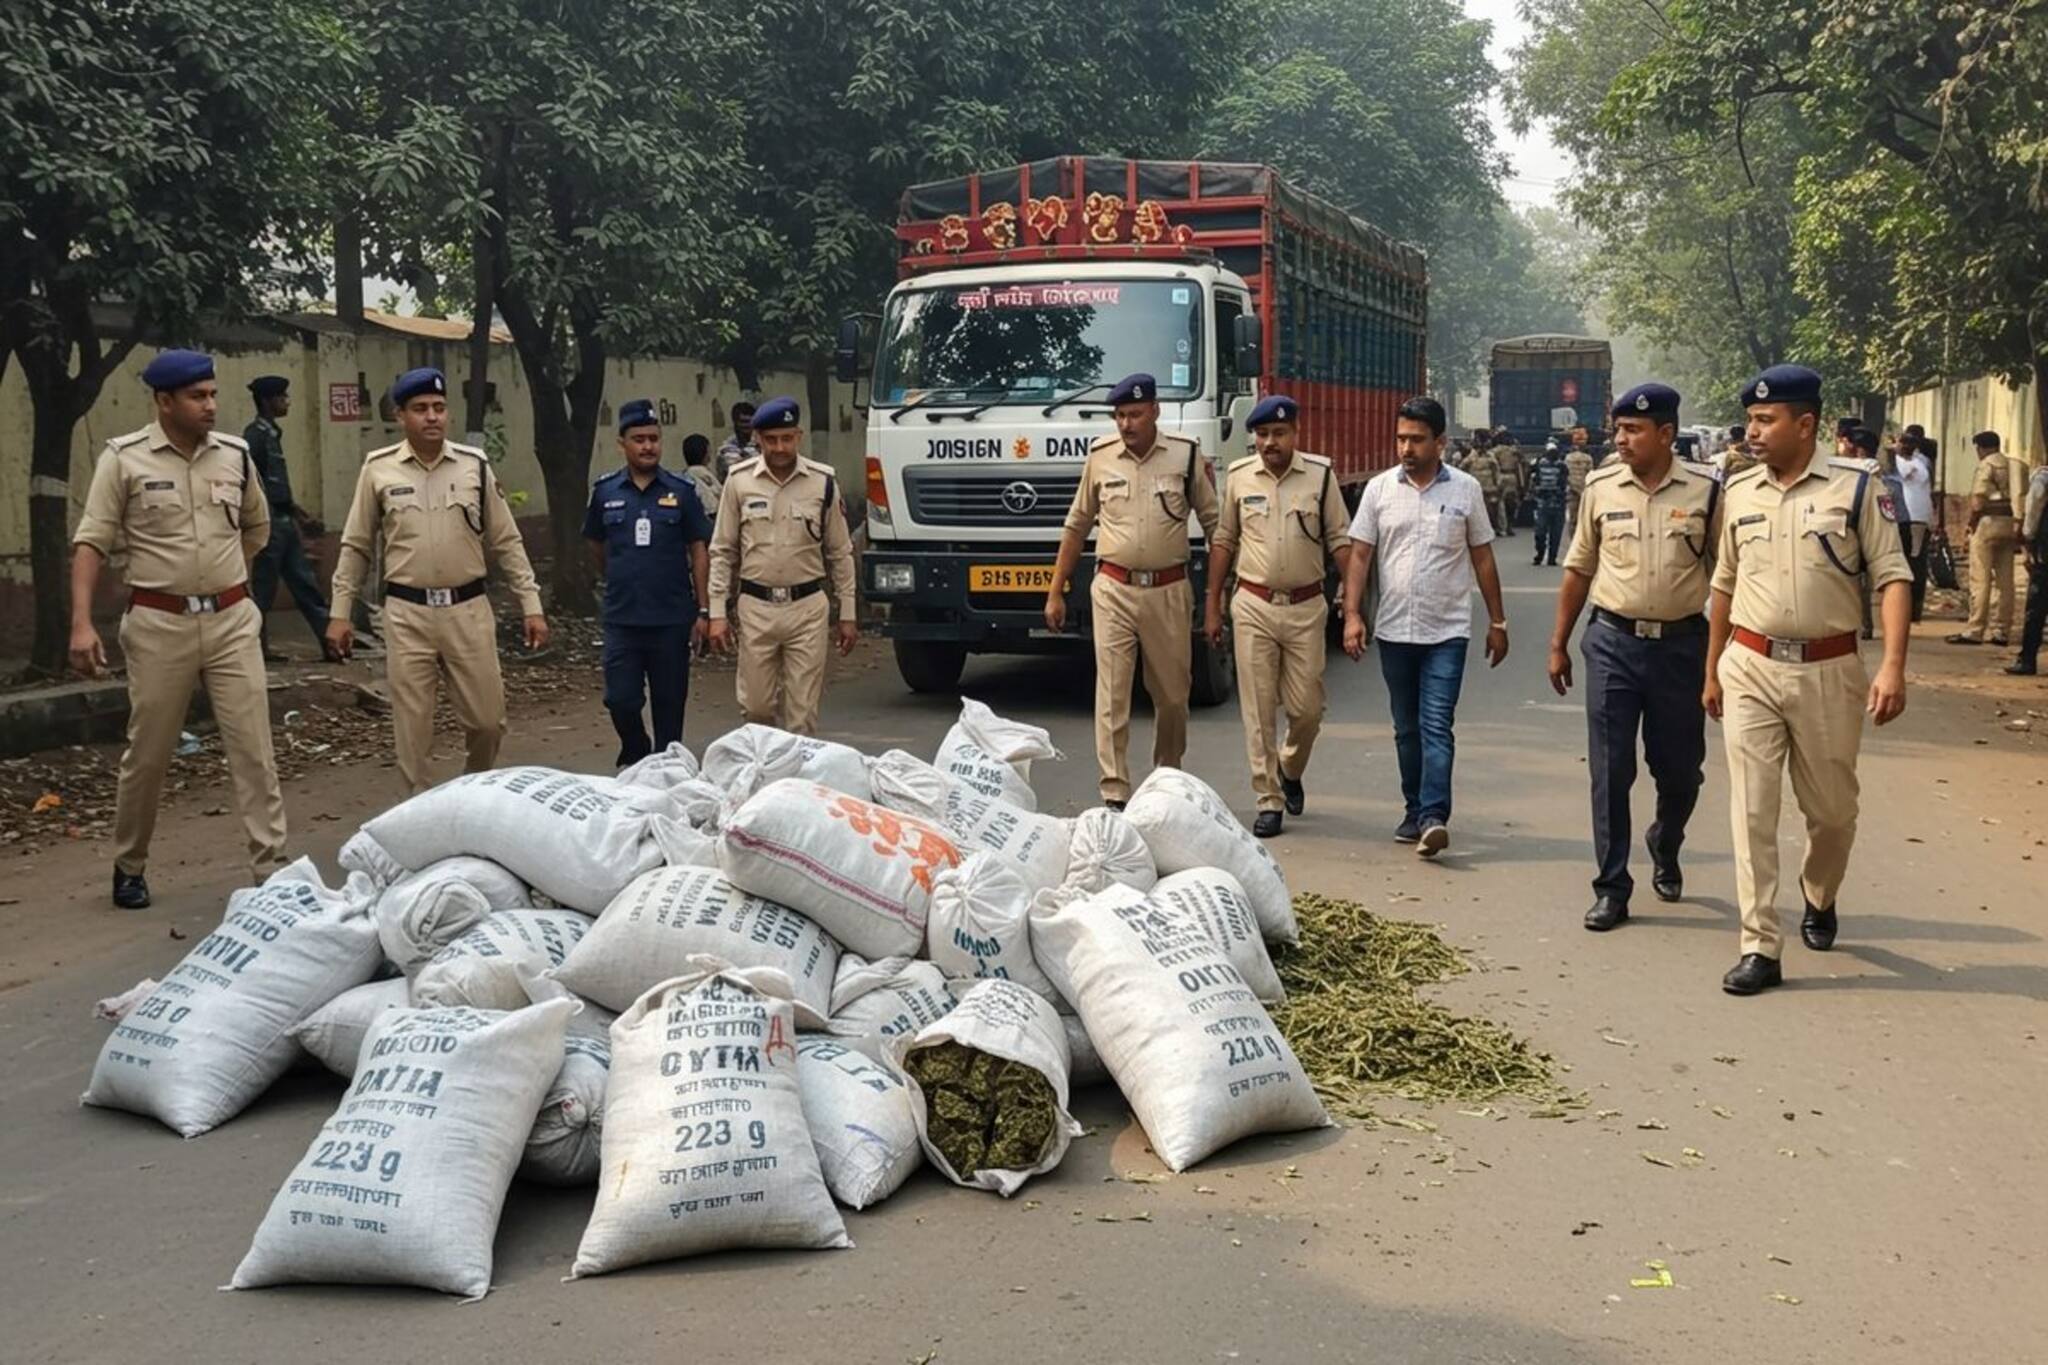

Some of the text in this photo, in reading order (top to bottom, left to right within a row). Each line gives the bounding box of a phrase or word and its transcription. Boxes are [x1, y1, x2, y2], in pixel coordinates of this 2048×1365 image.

[675, 1119, 766, 1152] 223 g
[311, 1140, 402, 1183] 223 g
